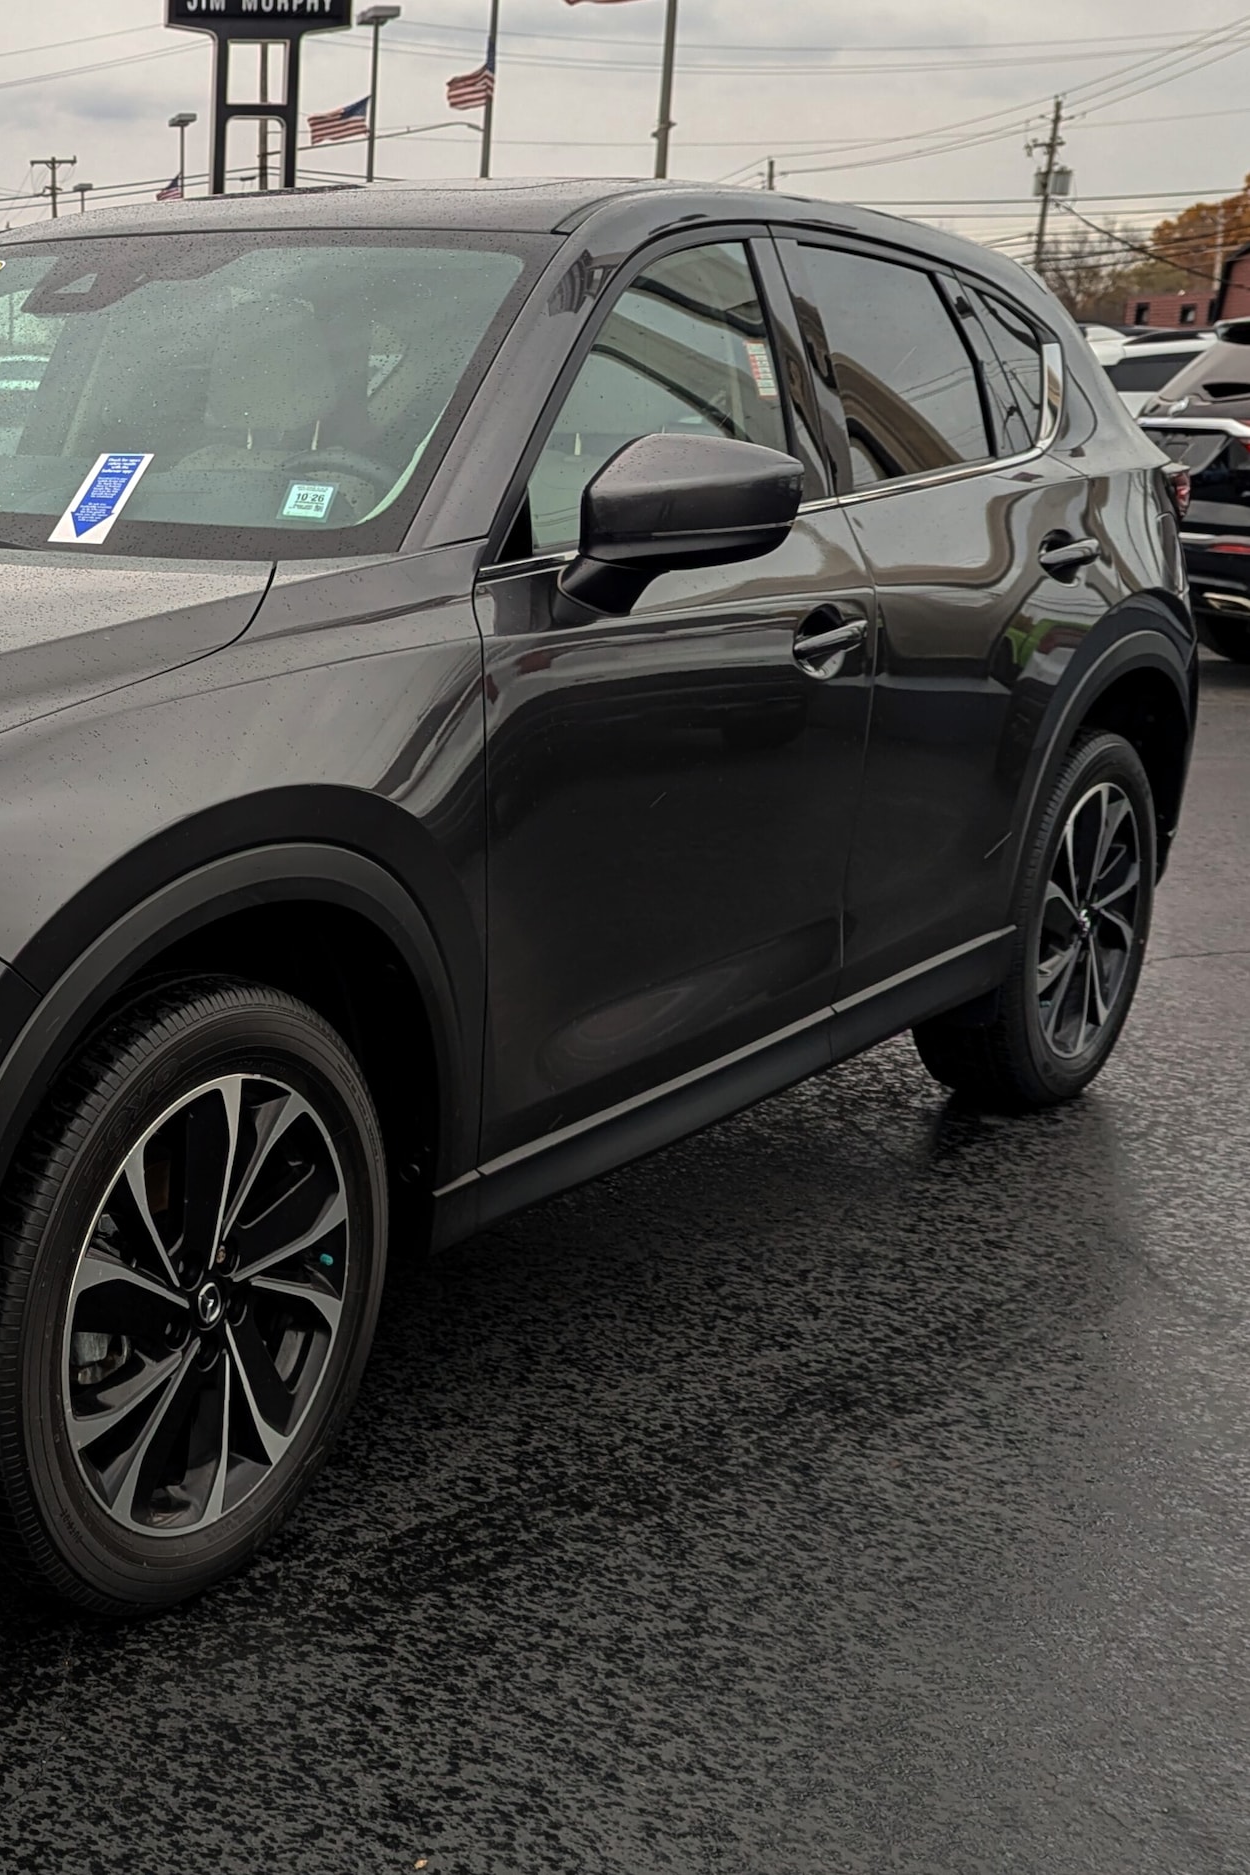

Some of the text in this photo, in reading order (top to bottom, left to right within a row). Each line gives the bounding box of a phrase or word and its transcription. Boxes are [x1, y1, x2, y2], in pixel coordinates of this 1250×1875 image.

[186, 0, 333, 13] JIM MURPHY
[297, 493, 325, 502] 10 26
